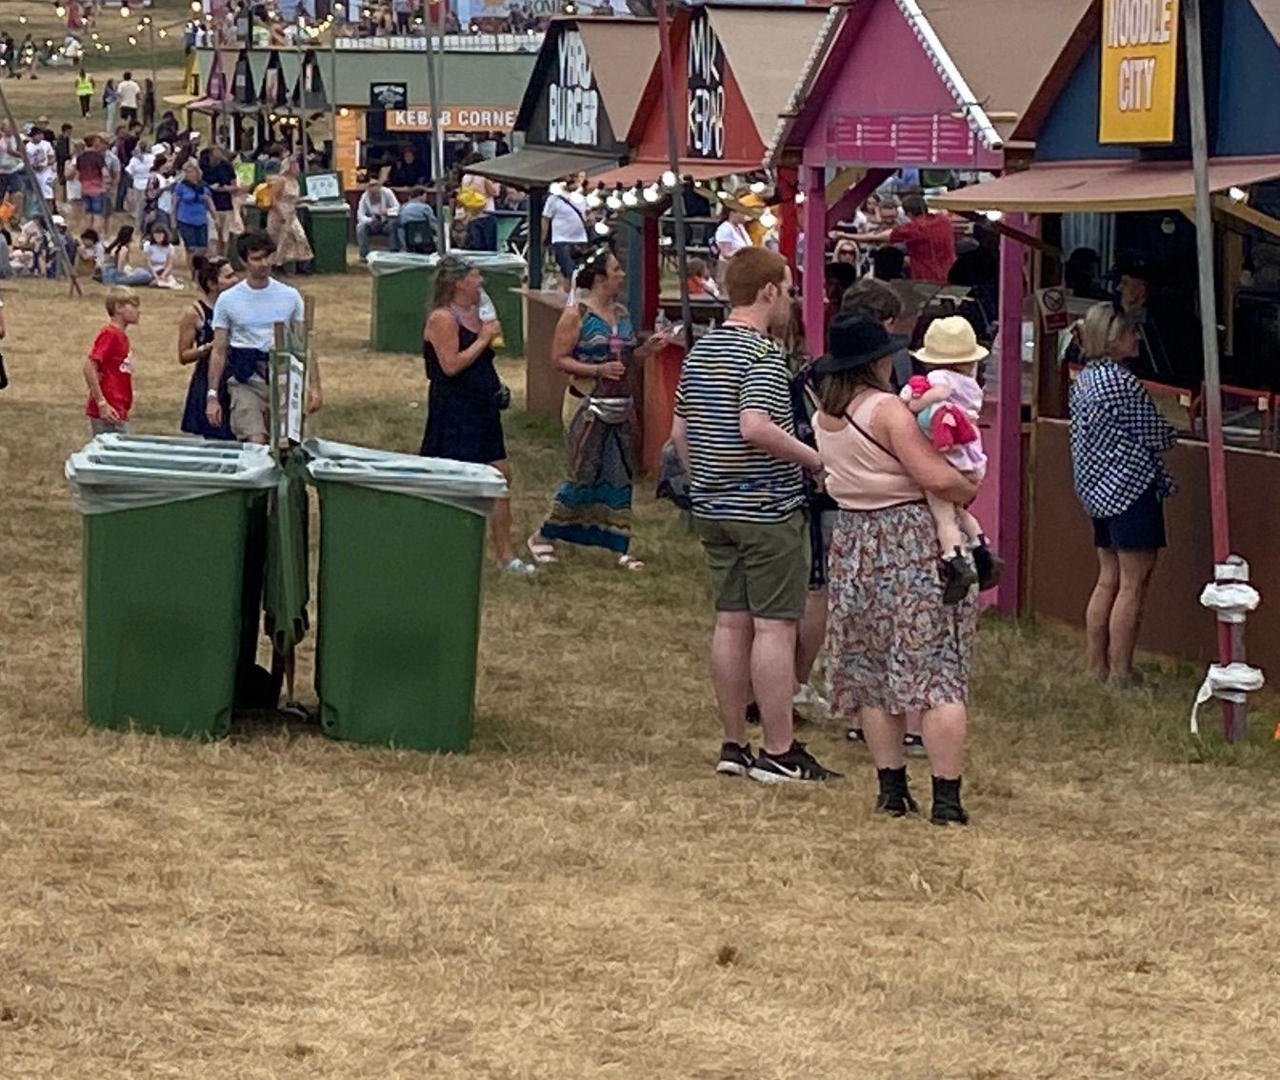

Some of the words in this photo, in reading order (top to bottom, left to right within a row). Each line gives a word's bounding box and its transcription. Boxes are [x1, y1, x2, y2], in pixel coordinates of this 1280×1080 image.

[1118, 56, 1157, 113] CITY
[395, 110, 452, 127] KEBB
[458, 110, 520, 127] CORNE
